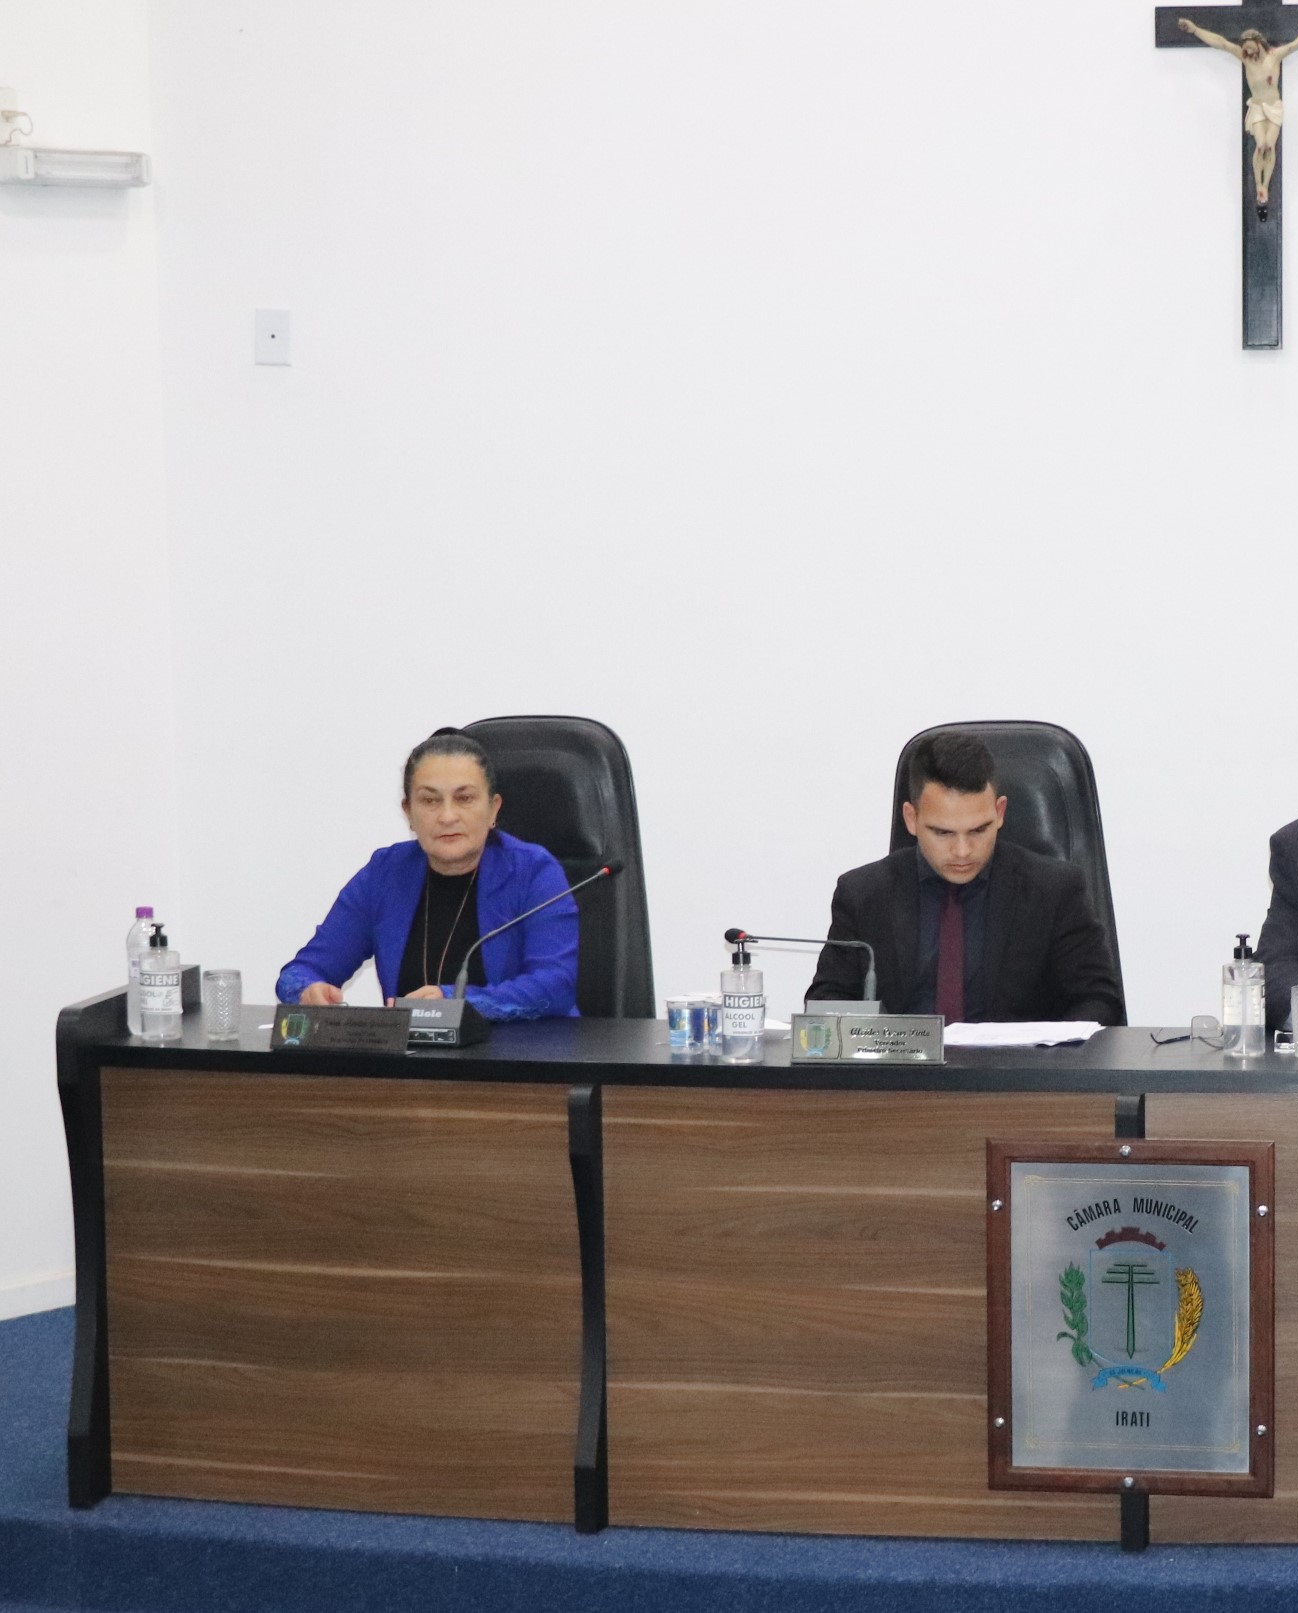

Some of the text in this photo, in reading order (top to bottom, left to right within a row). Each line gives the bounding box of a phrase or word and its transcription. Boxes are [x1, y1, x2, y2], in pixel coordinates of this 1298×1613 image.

[142, 974, 178, 986] GIENE
[412, 1008, 443, 1018] Riole
[1132, 1197, 1199, 1234] MUNICIPAL
[1115, 1410, 1150, 1427] IRATI
